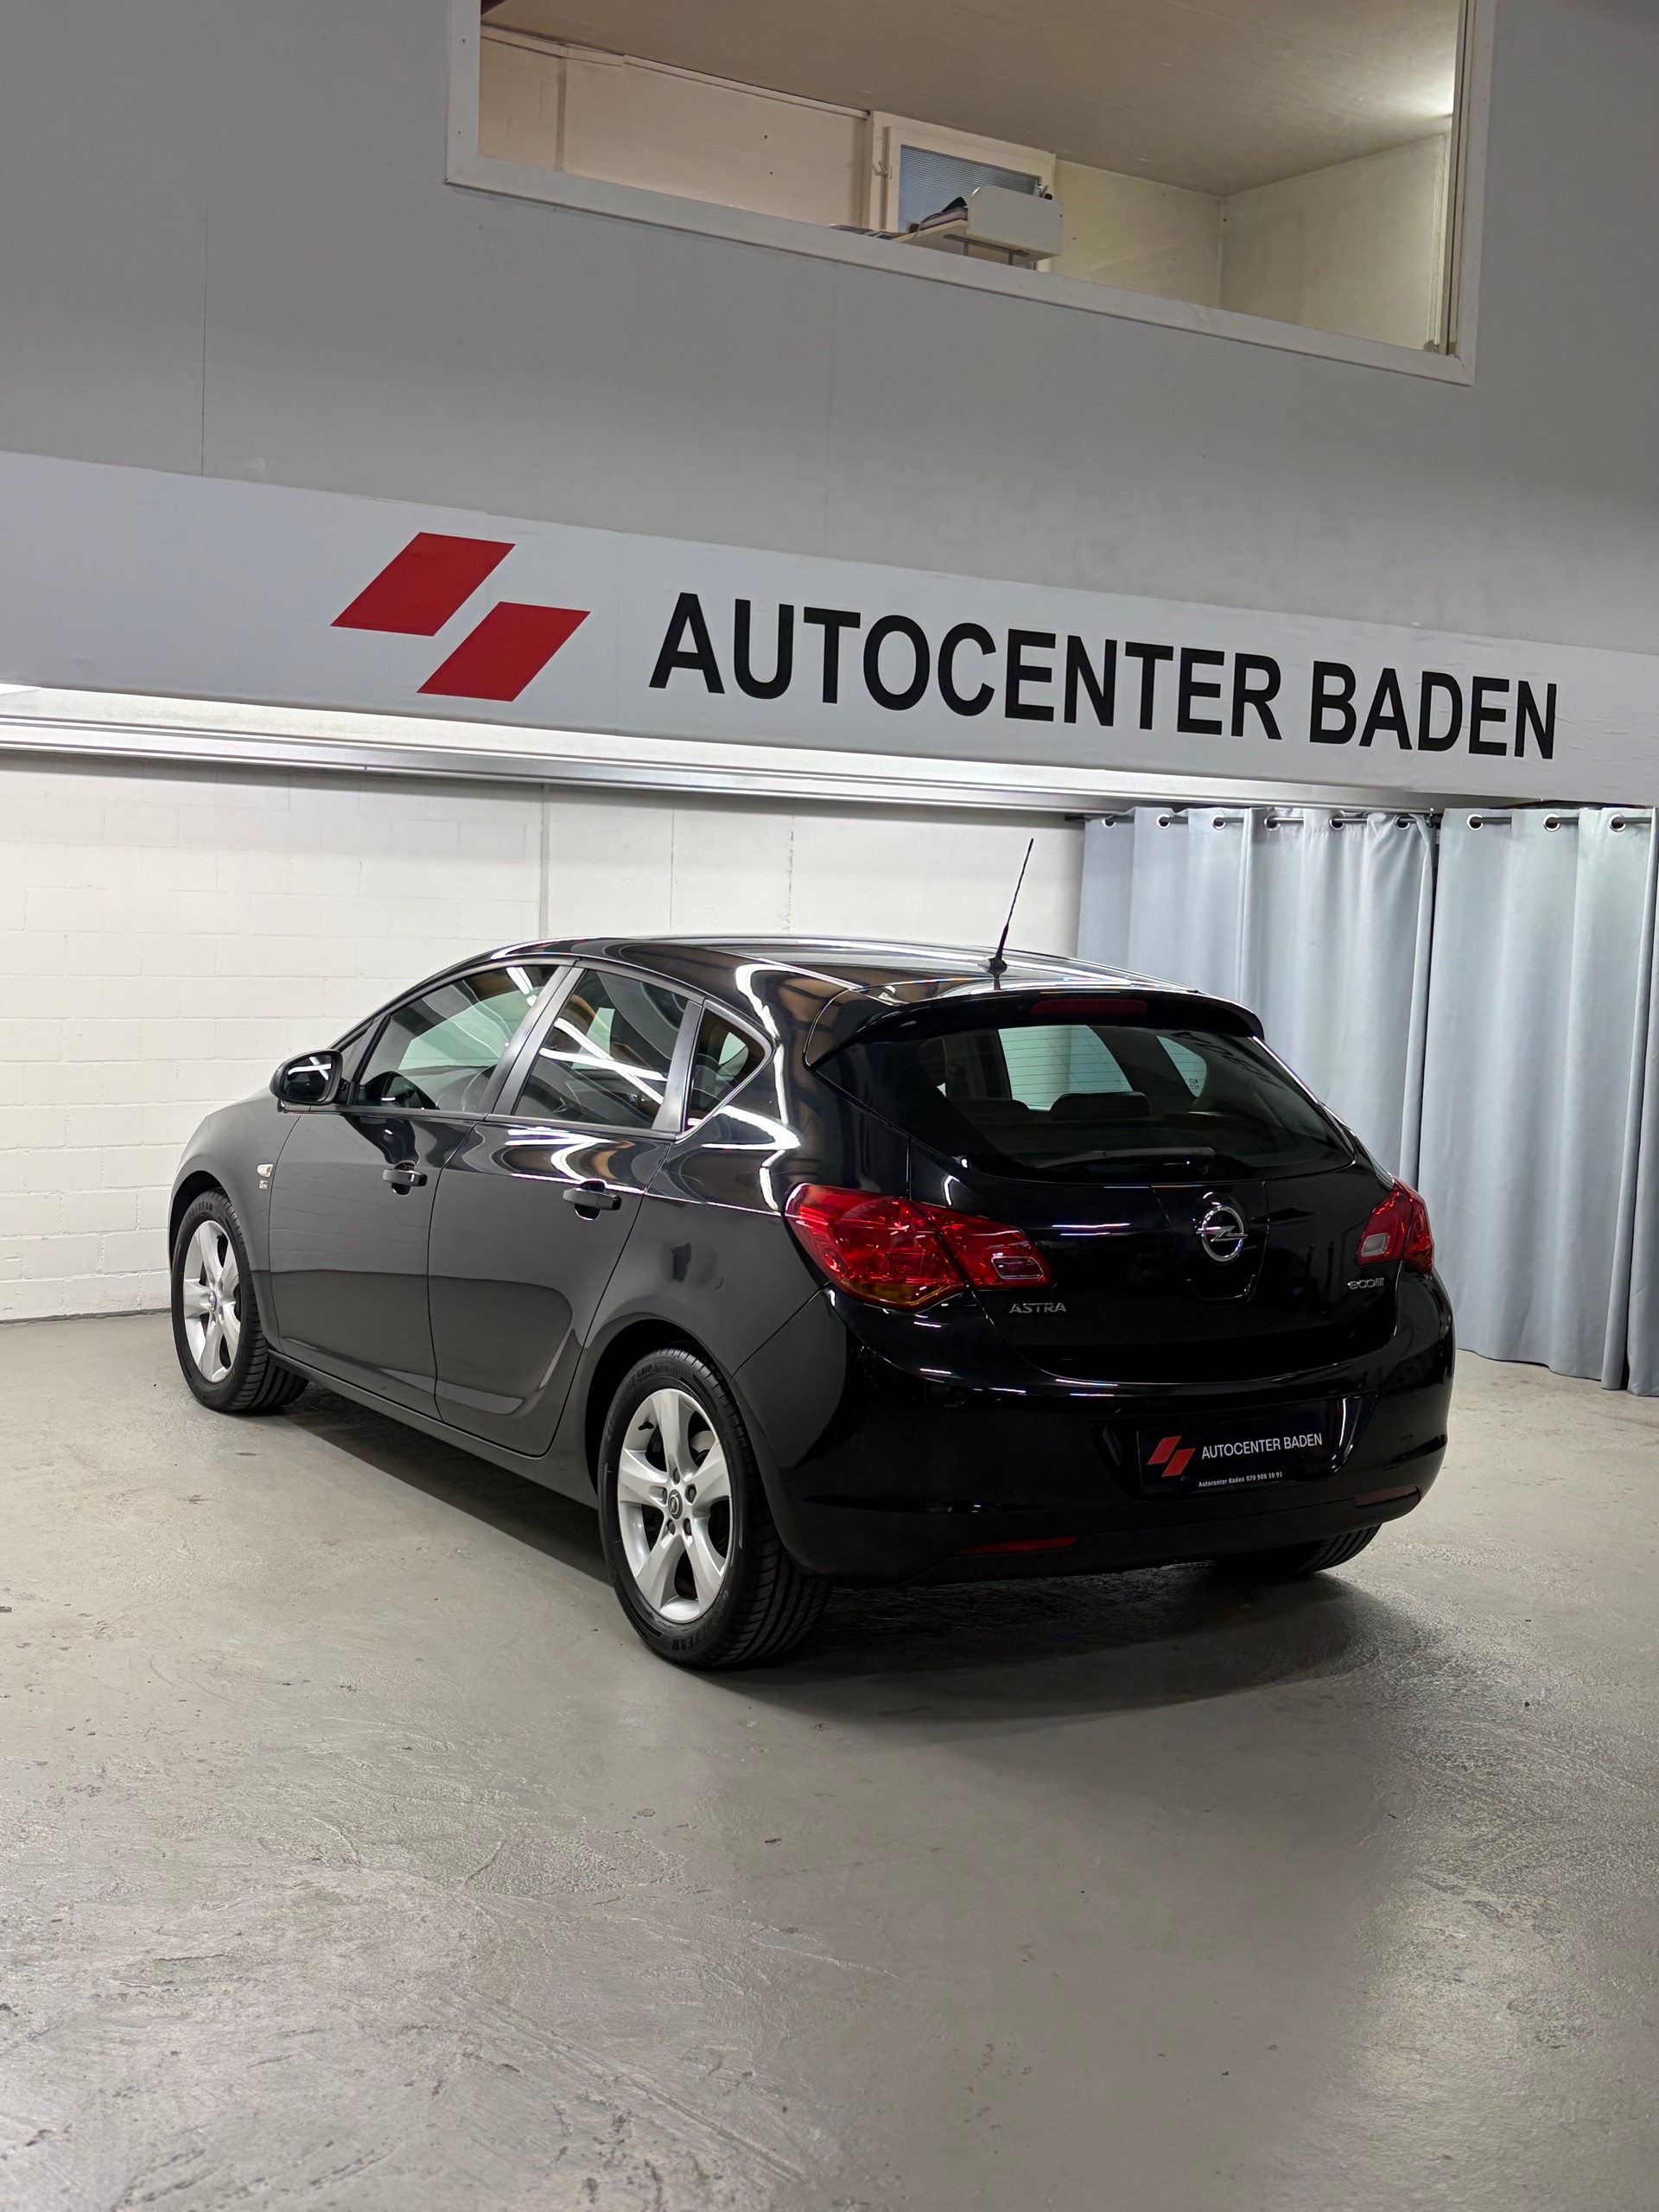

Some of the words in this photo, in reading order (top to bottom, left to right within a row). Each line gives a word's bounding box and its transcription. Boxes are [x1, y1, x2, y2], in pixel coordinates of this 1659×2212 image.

[648, 592, 1282, 741] AUTOCENTER
[1309, 660, 1557, 760] BADEN
[1008, 1302, 1067, 1313] ASTRA
[1201, 1437, 1281, 1460] AUTOCENTER
[1283, 1432, 1323, 1450] BADEN
[1198, 1478, 1228, 1488] Autocenter
[1245, 1474, 1256, 1483] 079
